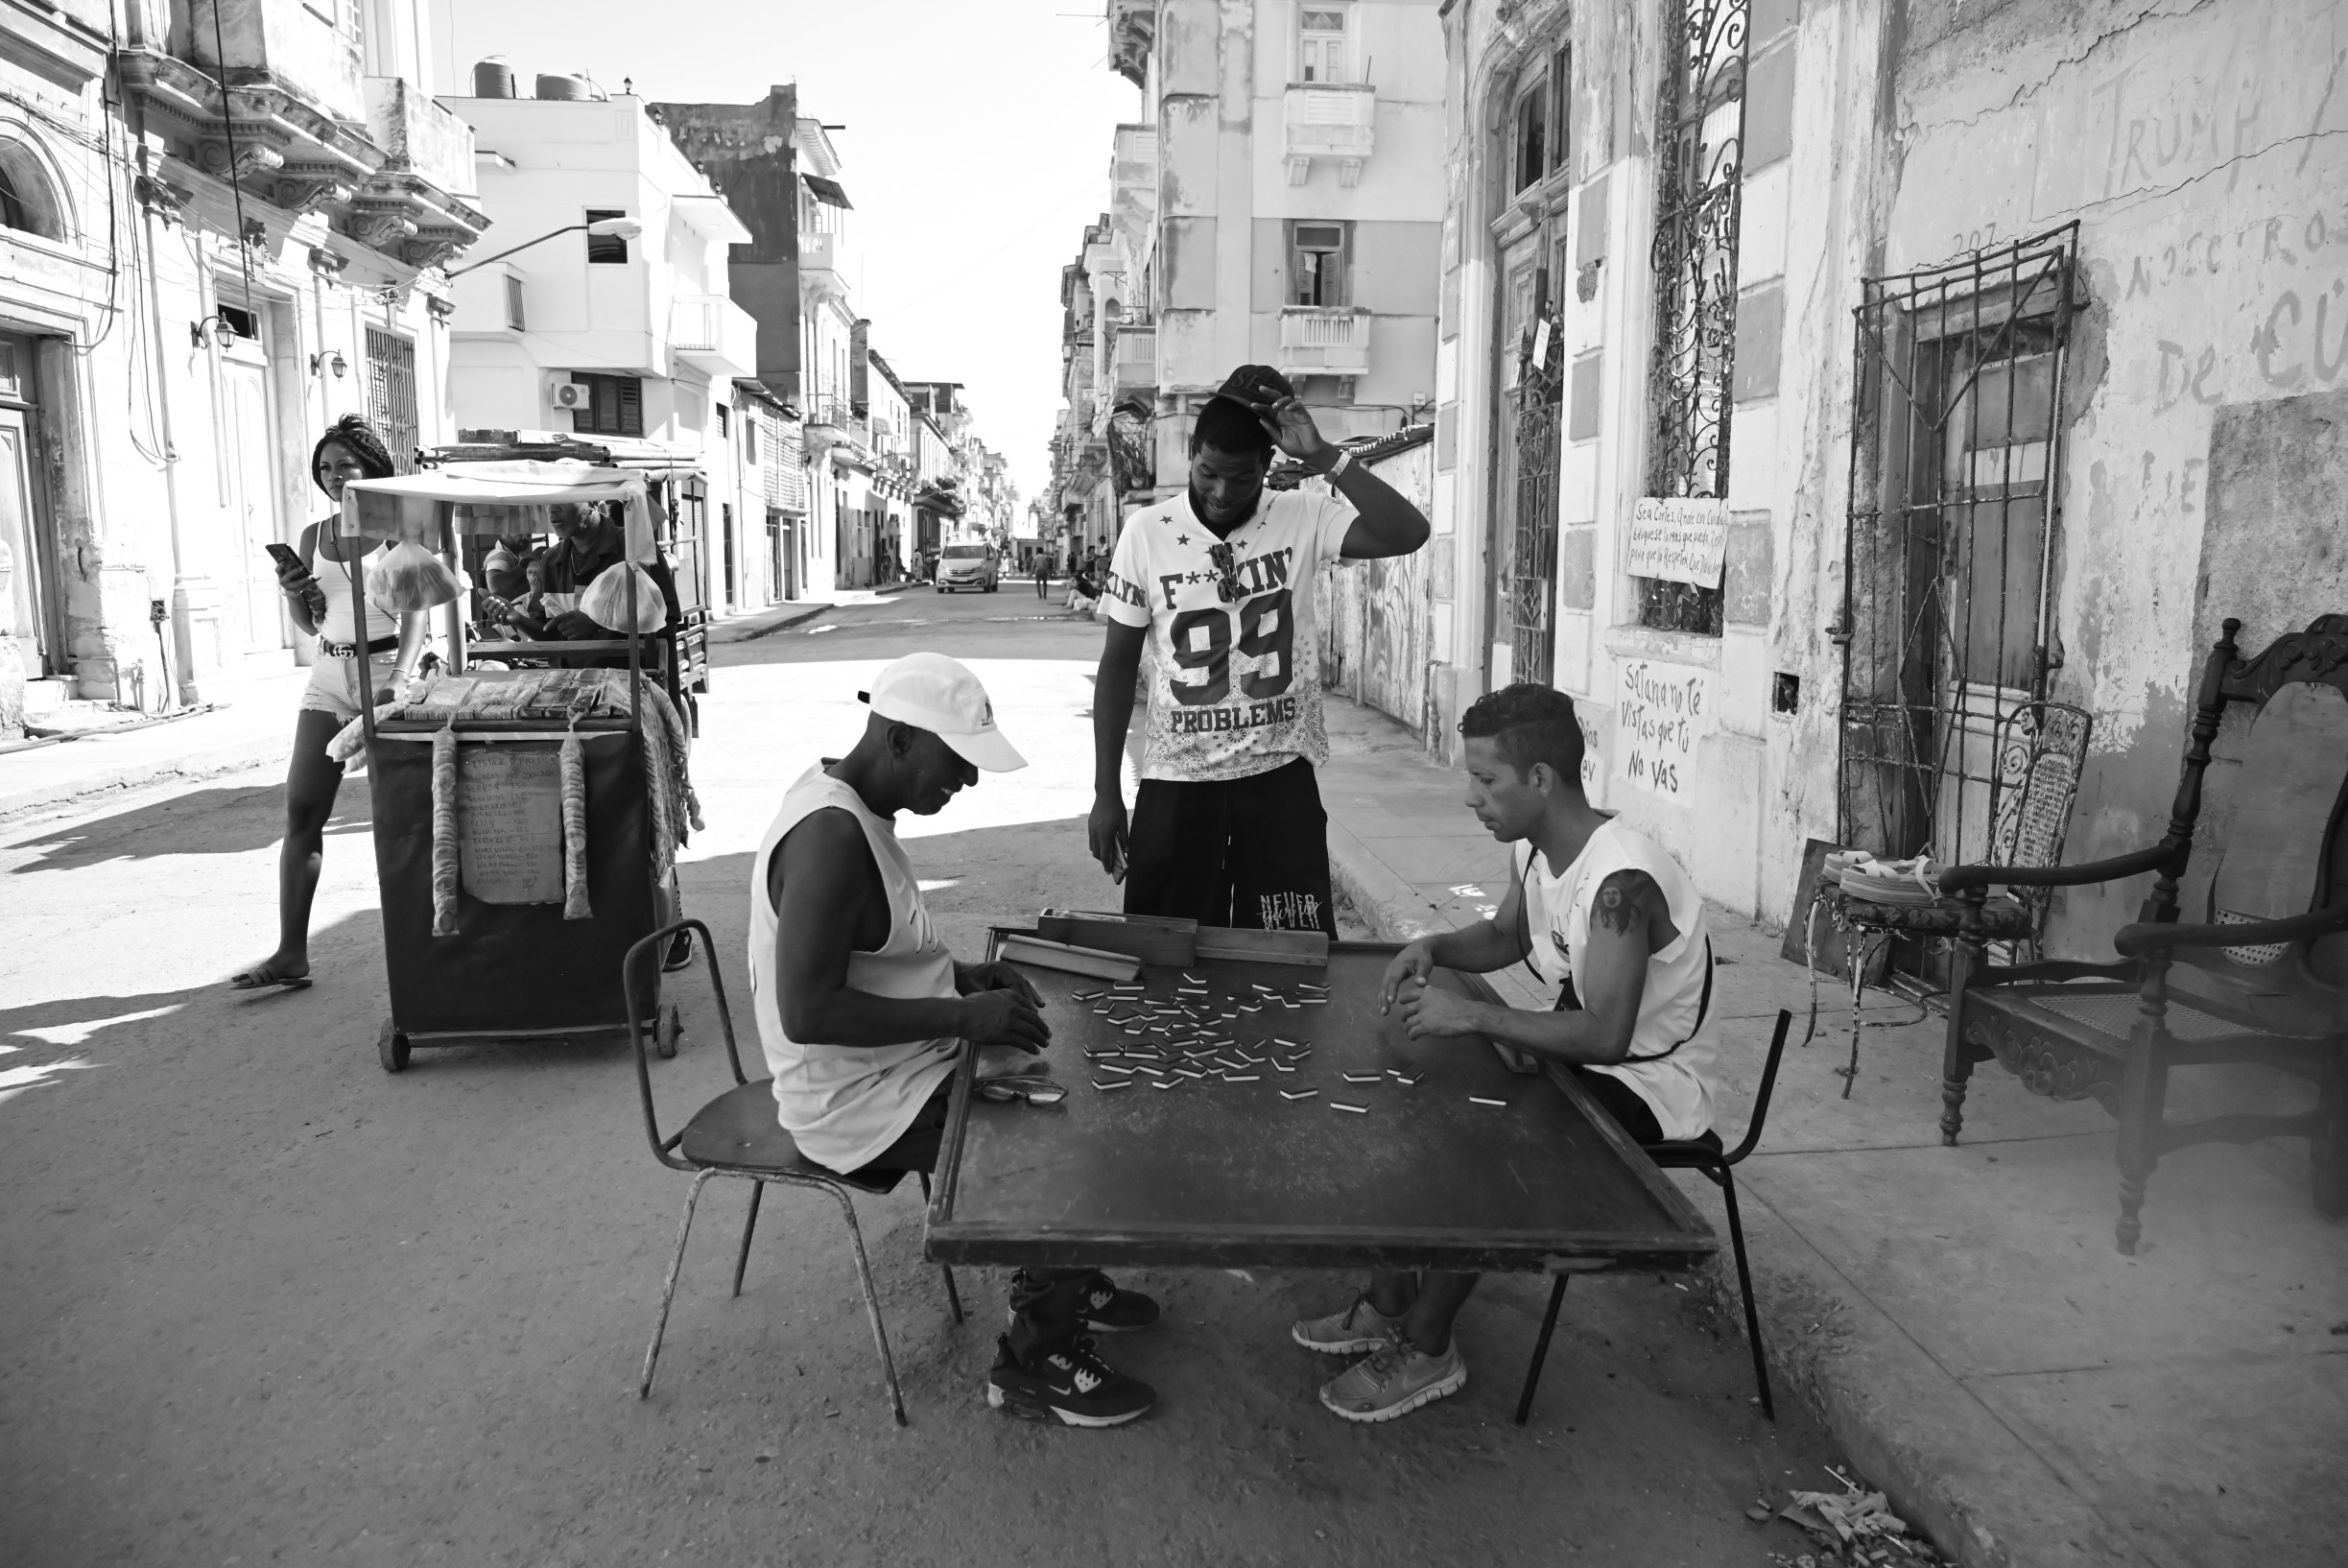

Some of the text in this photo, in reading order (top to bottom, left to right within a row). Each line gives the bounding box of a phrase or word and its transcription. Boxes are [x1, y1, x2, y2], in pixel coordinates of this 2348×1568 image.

[1636, 503, 1652, 521] Sea
[1646, 550, 1657, 570] que
[1169, 587, 1294, 706] 99
[1170, 697, 1296, 733] PROBLEMS
[1657, 720, 1674, 750] que
[1627, 748, 1644, 779] No
